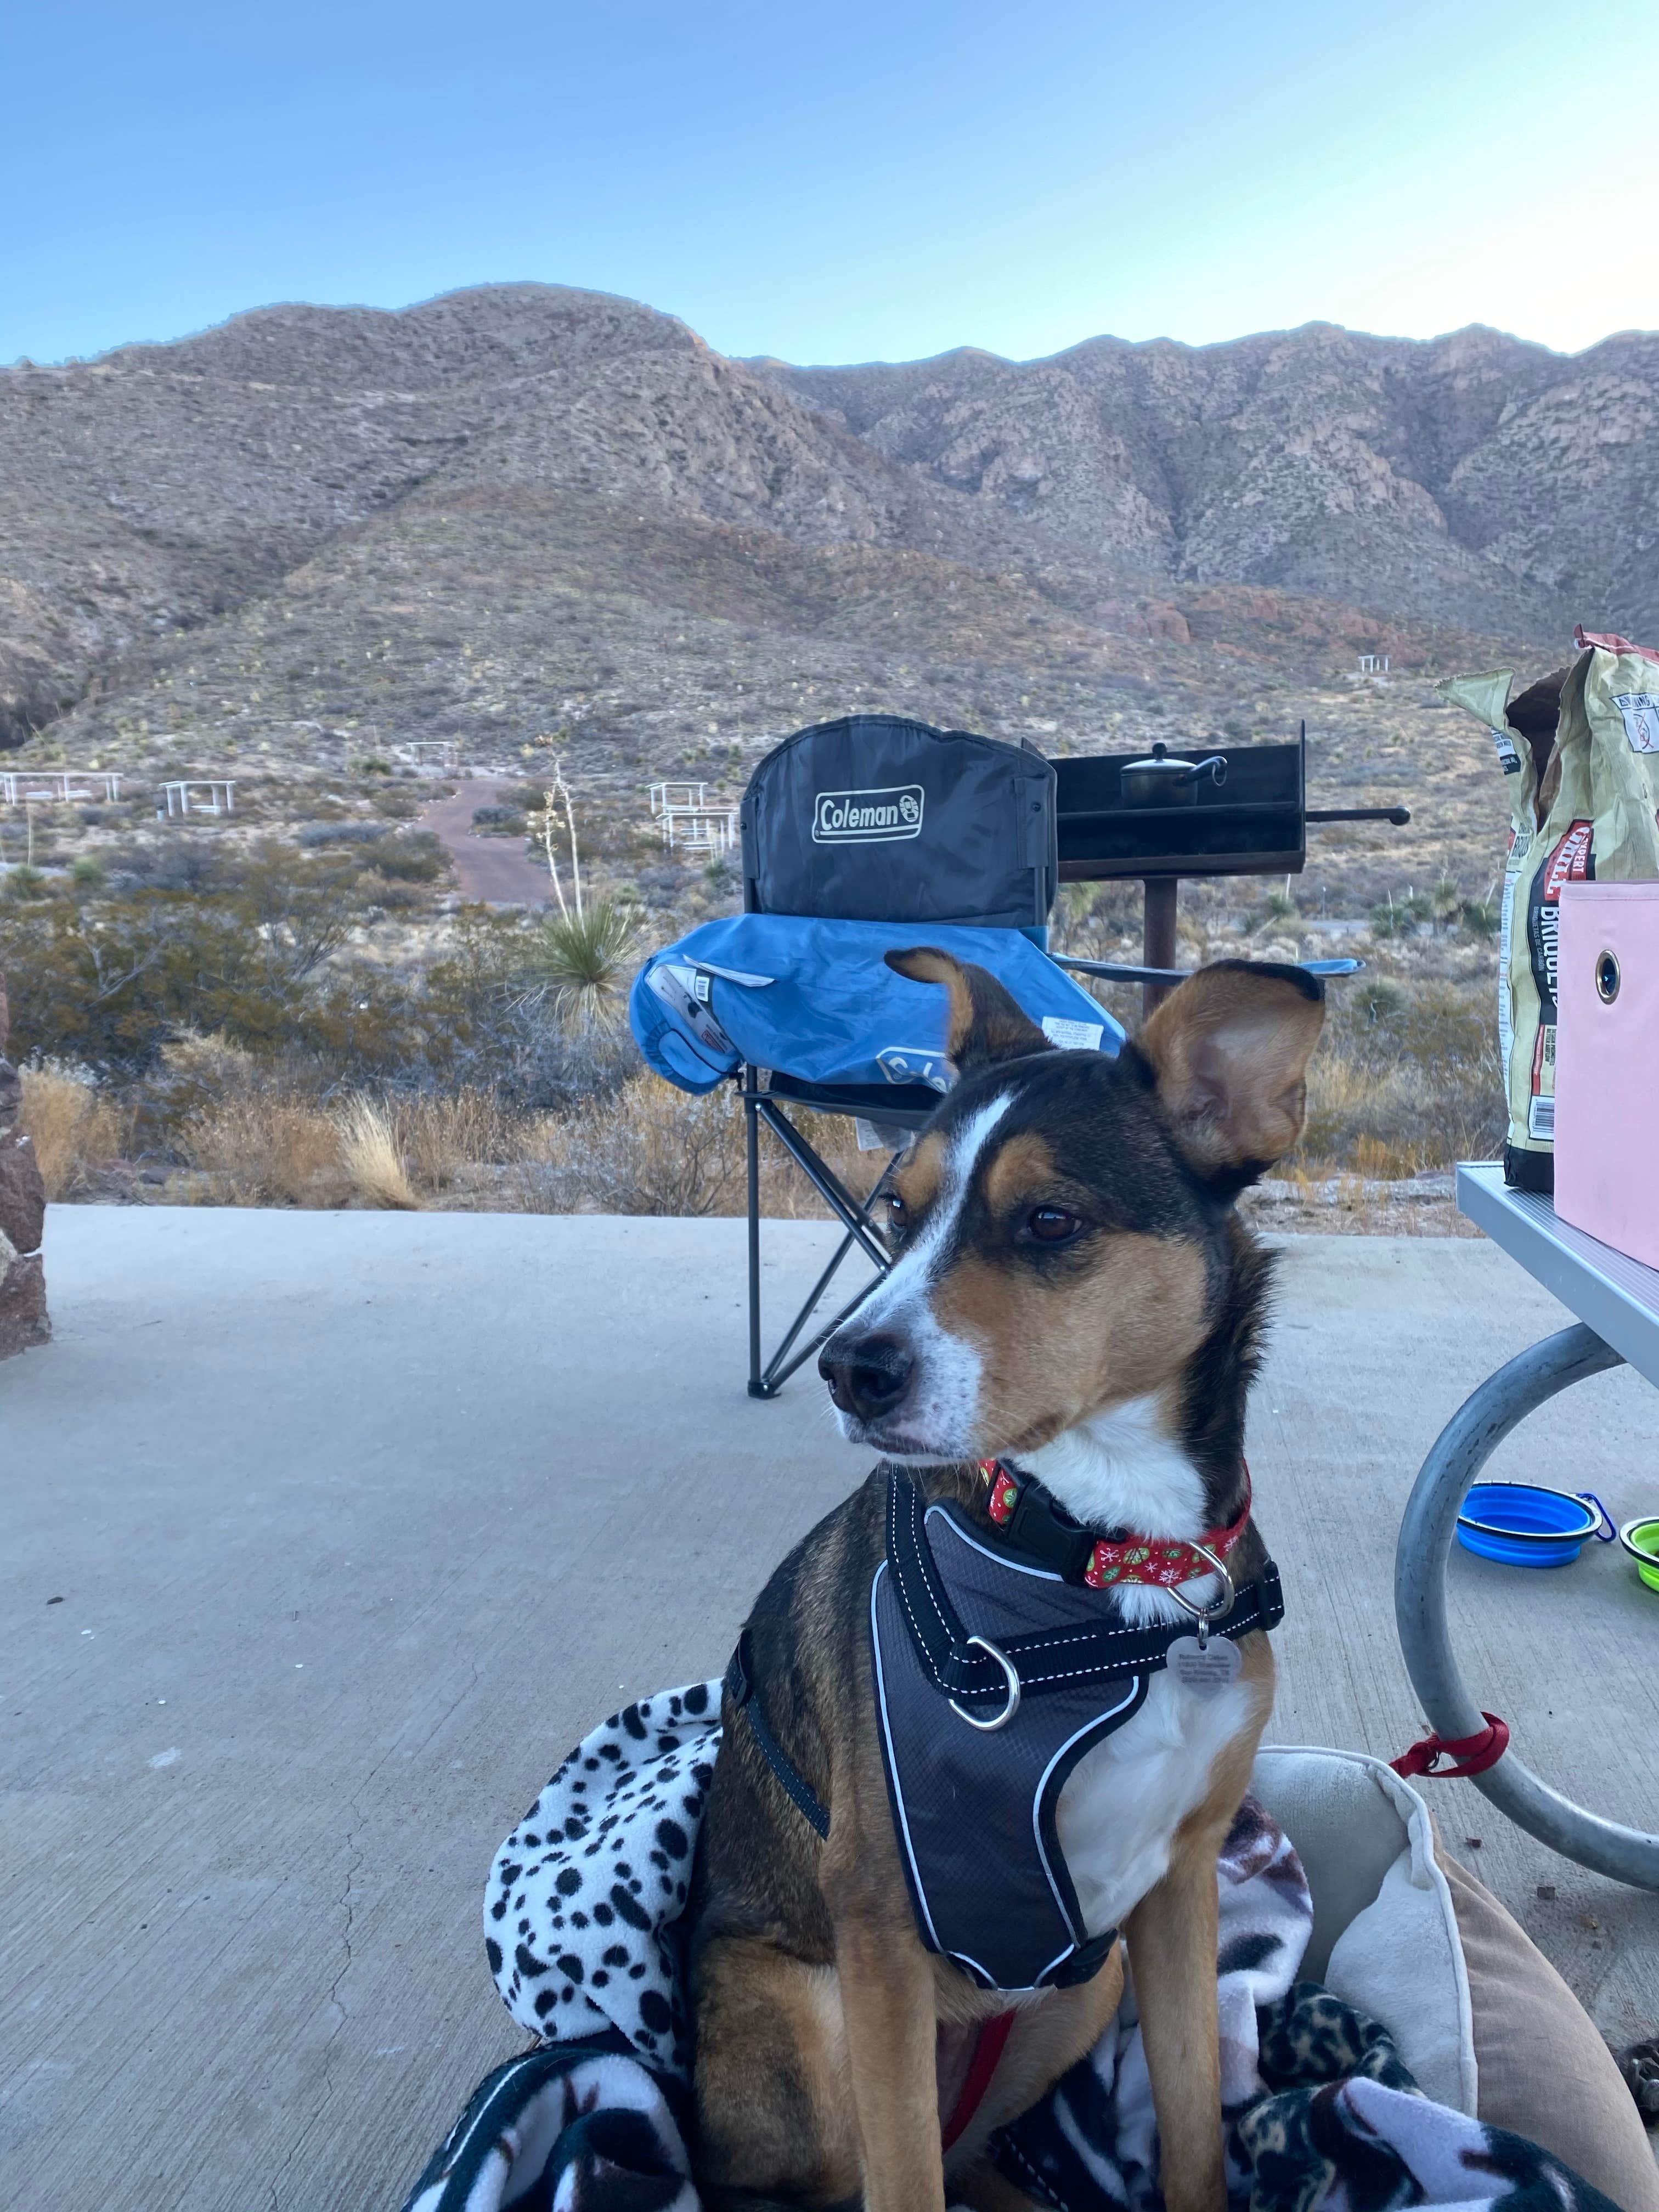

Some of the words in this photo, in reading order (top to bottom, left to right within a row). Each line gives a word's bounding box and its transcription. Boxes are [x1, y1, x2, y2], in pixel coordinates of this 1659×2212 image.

[821, 799, 898, 831] Coleman
[1572, 834, 1589, 873] XPERT
[1534, 938, 1541, 946] DE
[1541, 906, 1559, 1008] BRIQU
